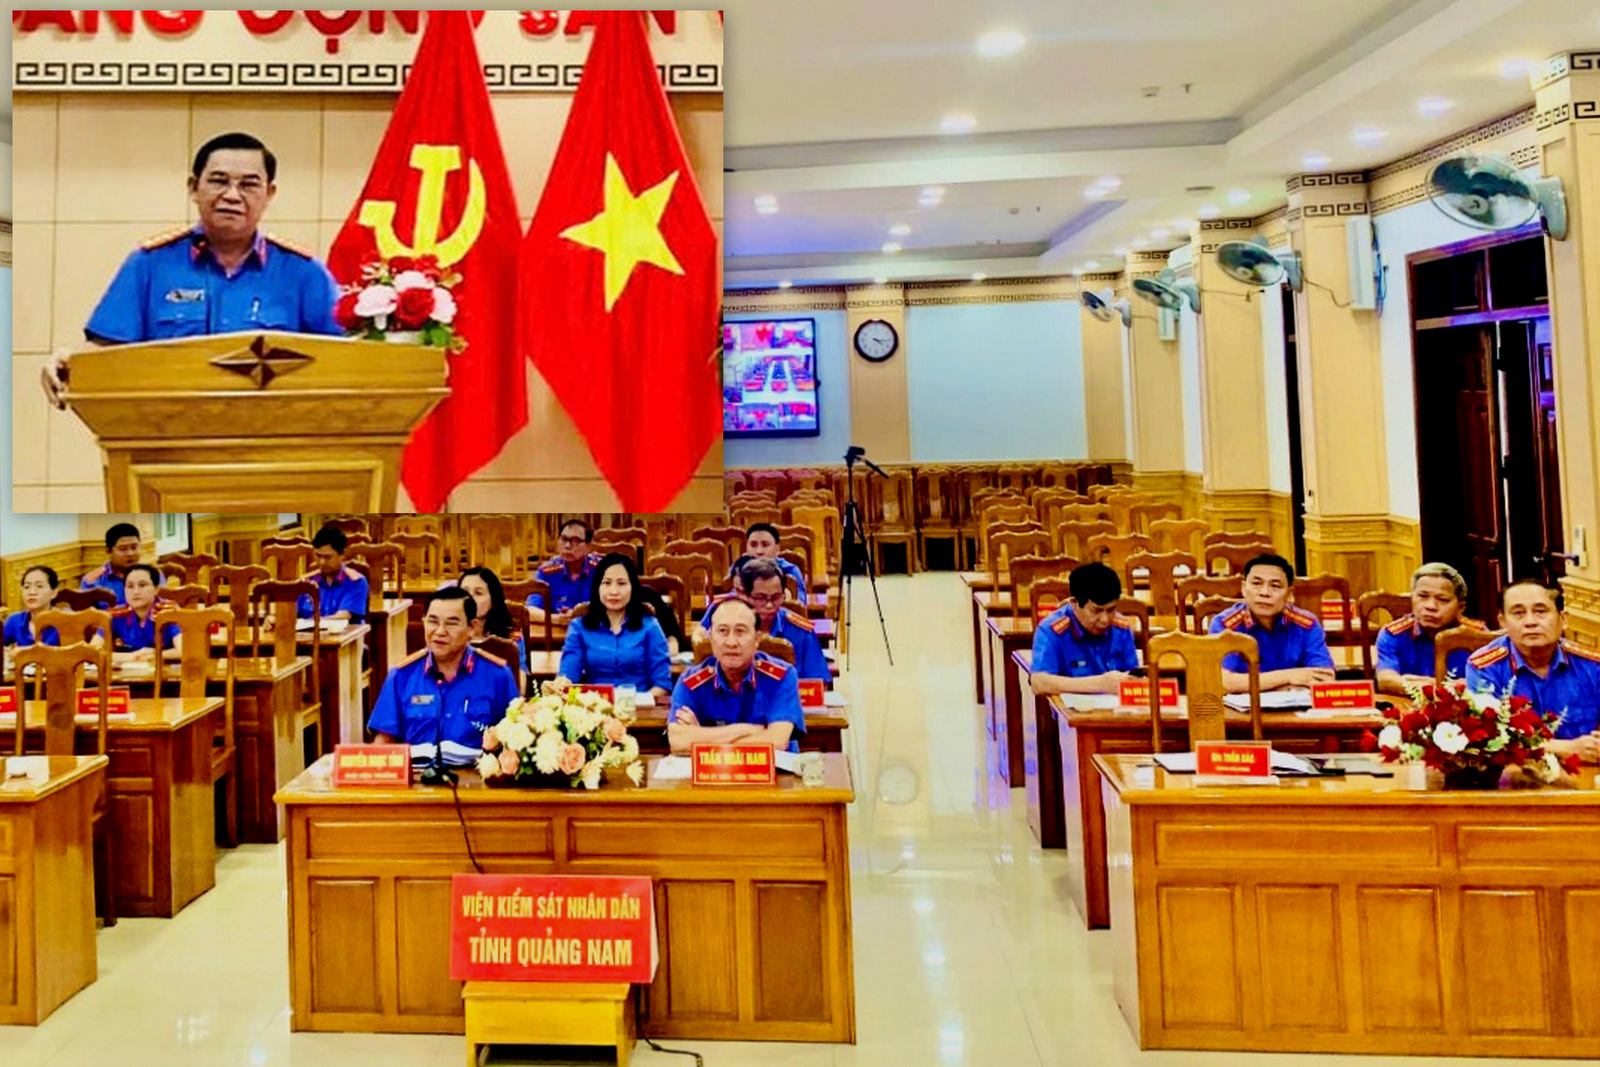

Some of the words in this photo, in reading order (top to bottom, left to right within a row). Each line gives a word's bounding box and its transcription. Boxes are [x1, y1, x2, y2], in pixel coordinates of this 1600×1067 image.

[462, 891, 493, 922] VIỆN
[497, 887, 533, 918] KIỂM
[537, 892, 564, 919] SÁT
[567, 892, 607, 919] NHÂN
[610, 892, 640, 919] DÂN
[469, 927, 512, 964] TỈNH
[517, 927, 582, 967] QUẢNG
[587, 939, 632, 966] NAM
